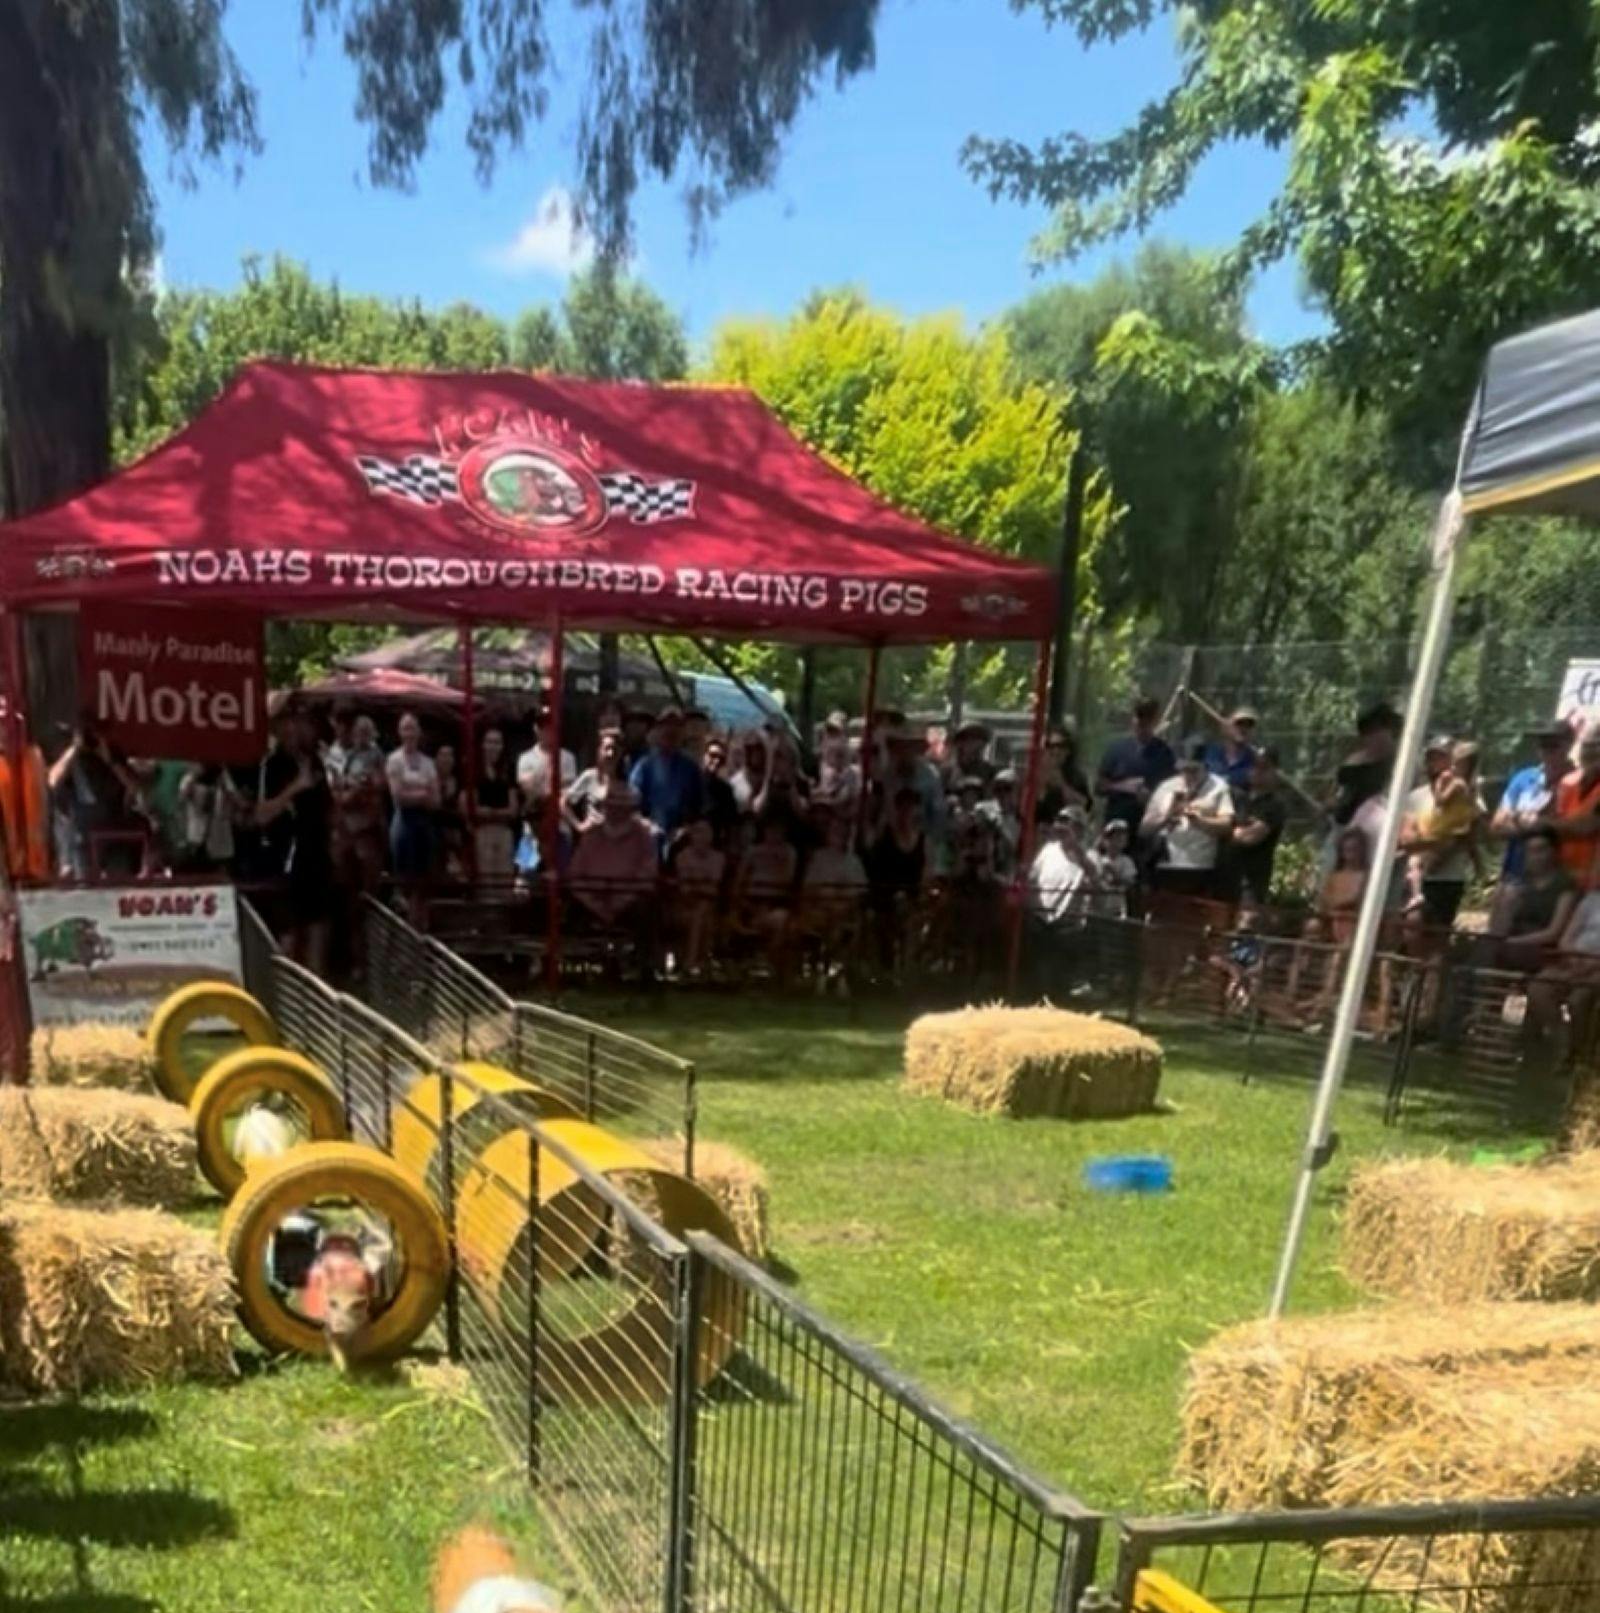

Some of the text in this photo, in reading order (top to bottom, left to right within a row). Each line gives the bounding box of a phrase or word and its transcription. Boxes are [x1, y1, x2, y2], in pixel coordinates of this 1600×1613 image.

[154, 549, 930, 616] NOAHS THOROUGHBRED RACING PIGS
[93, 630, 256, 664] Manly Paradise
[98, 669, 255, 732] Motel
